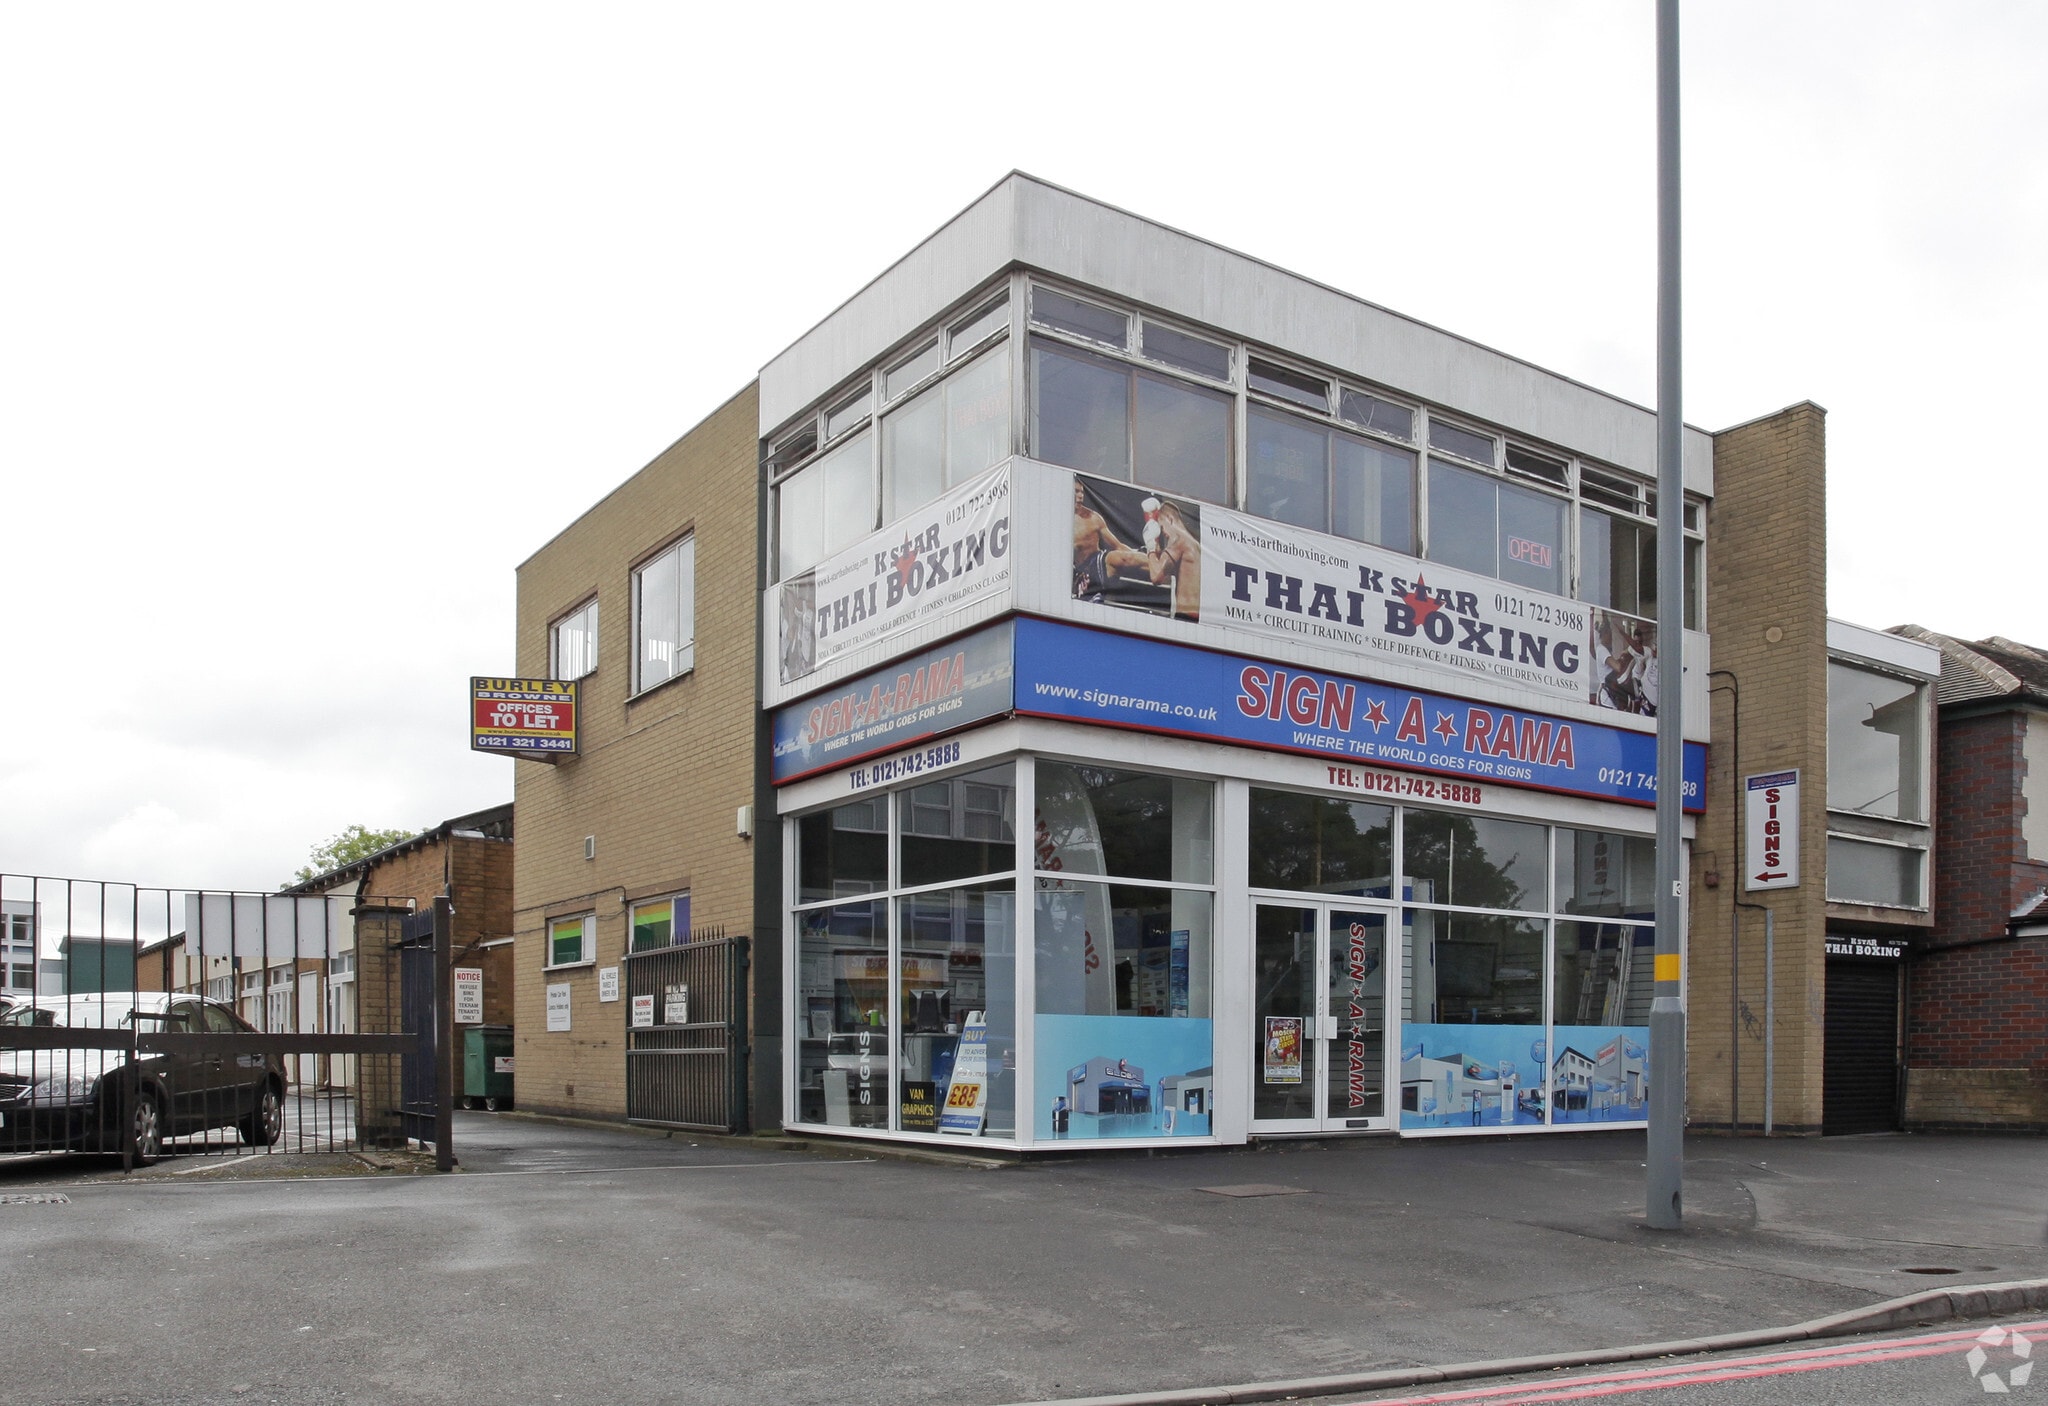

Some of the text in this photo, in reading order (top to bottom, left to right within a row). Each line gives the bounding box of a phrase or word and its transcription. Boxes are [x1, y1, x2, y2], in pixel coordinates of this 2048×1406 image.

[946, 504, 966, 526] 0121
[1210, 525, 1349, 570] www.k-starthaiboxing.com
[1509, 537, 1550, 567] OPEN
[818, 516, 1009, 639] THAI BOXING
[880, 621, 892, 633] SELF
[892, 610, 917, 626] DEFENCE
[921, 597, 944, 615] FITNESS
[948, 581, 982, 603] CHILDRENS
[982, 569, 1009, 588] CLASSES
[1224, 561, 1579, 674] THAI BOXING
[1494, 593, 1583, 632] 0121 722 3988
[1225, 606, 1579, 691] MMA CIRCUIT TRAINING SELF DEFENCE FITNESS CHILDRENS CLASSES
[475, 679, 572, 693] BURLEY
[478, 692, 570, 701] BROWNE
[807, 693, 856, 745] SIGN
[892, 651, 965, 714] RAMA
[1035, 682, 1217, 721] www.signarama.co.uk
[490, 712, 559, 729] TO LET
[497, 702, 553, 714] OFFICES
[824, 696, 963, 752] WHERE THE WORLD GOES FOR SIGNS
[1236, 665, 1576, 770] SIGN A RAMA
[478, 737, 571, 749] 0121 321 3441
[1293, 731, 1532, 780] WHERE THE WORLD GOES FOR SIGNS
[850, 741, 961, 790] TEL: 0121-742-5888
[1598, 767, 1632, 786] 0121
[1327, 766, 1482, 805] TEL: 0121-742-5888
[1764, 788, 1781, 867] SIGNS
[1825, 943, 1900, 957] THAI BOXING
[457, 972, 481, 981] NOTICE
[1348, 922, 1366, 1109] SIGN A RAMA
[965, 1030, 986, 1041] BUY
[860, 1030, 870, 1105] SIGNS
[902, 1103, 934, 1116] GRAPHICS
[909, 1088, 924, 1100] VAN
[948, 1085, 978, 1107] £85
